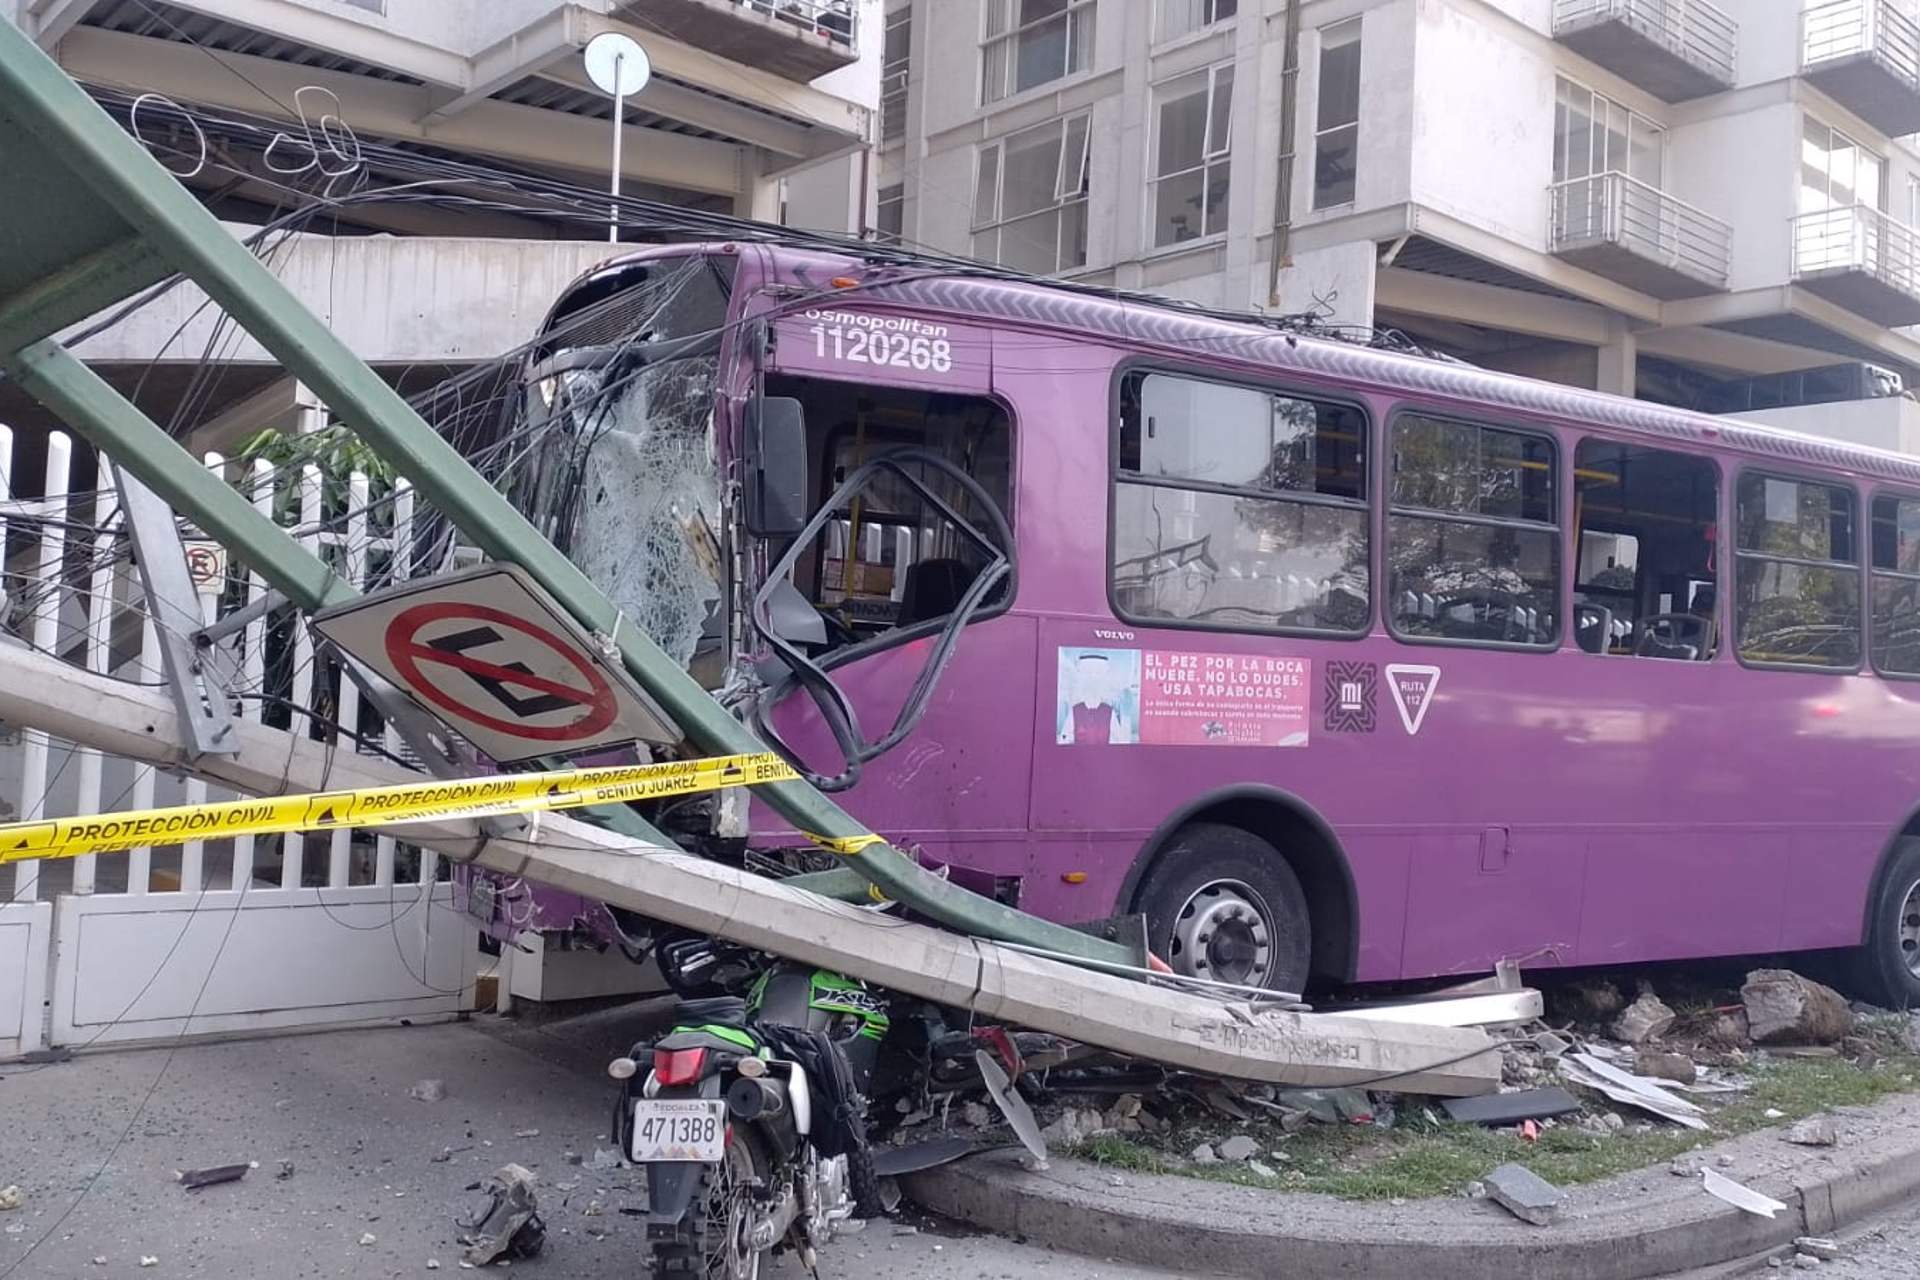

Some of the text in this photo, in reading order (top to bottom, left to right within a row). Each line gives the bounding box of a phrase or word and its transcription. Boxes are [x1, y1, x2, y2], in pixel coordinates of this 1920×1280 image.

[810, 322, 952, 373] 1120268
[1094, 629, 1135, 641] VOLVO
[1145, 653, 1304, 673] EL PEZ POR LA BOCA
[1145, 669, 1304, 687] MUERE. NO LO DUDES.
[1163, 683, 1287, 700] USA TAPABOCAS.
[1400, 681, 1426, 694] RUTA
[1406, 695, 1421, 706] 112
[670, 761, 699, 776] CIVIL
[479, 780, 516, 797] CIVIL
[226, 804, 276, 826] CIVIL
[642, 1117, 716, 1143] 4713B8
